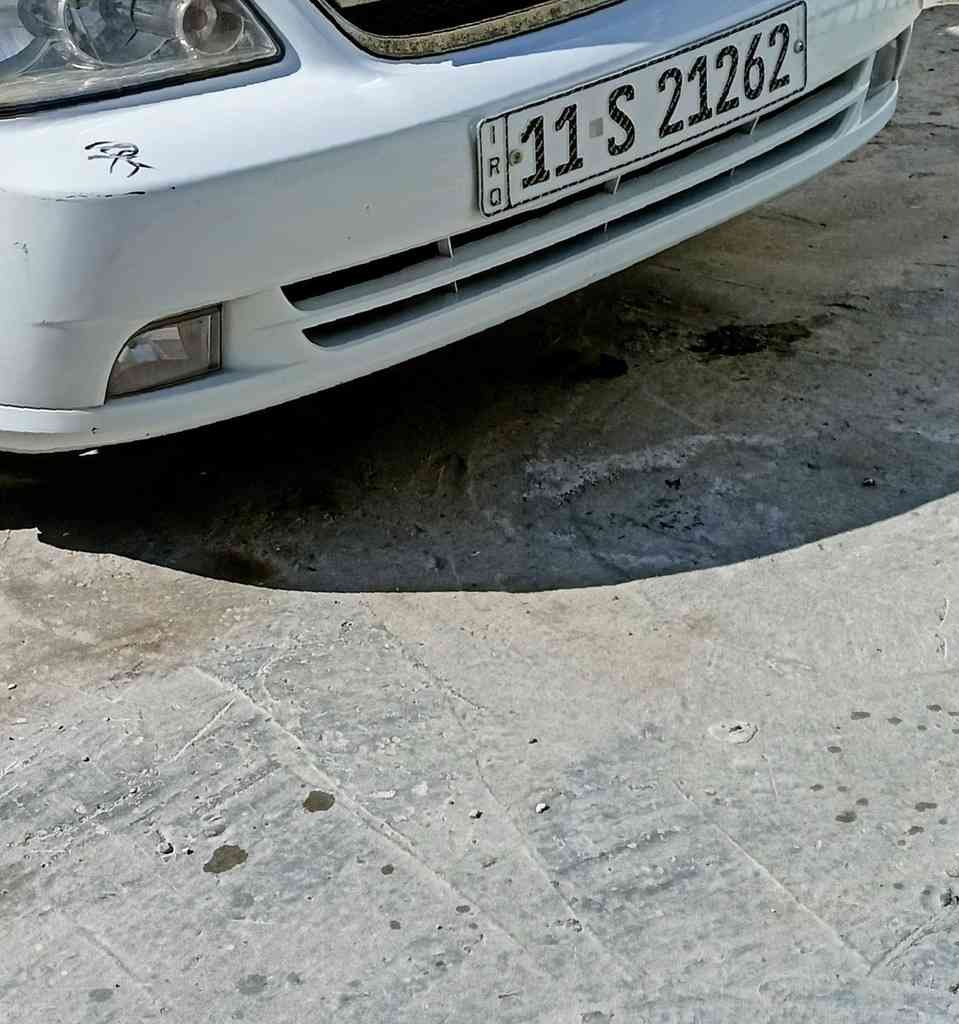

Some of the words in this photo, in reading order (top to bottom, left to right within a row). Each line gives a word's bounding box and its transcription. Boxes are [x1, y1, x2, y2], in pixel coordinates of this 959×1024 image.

[521, 104, 584, 189] 11
[607, 83, 637, 157] S
[657, 22, 791, 139] 21262
